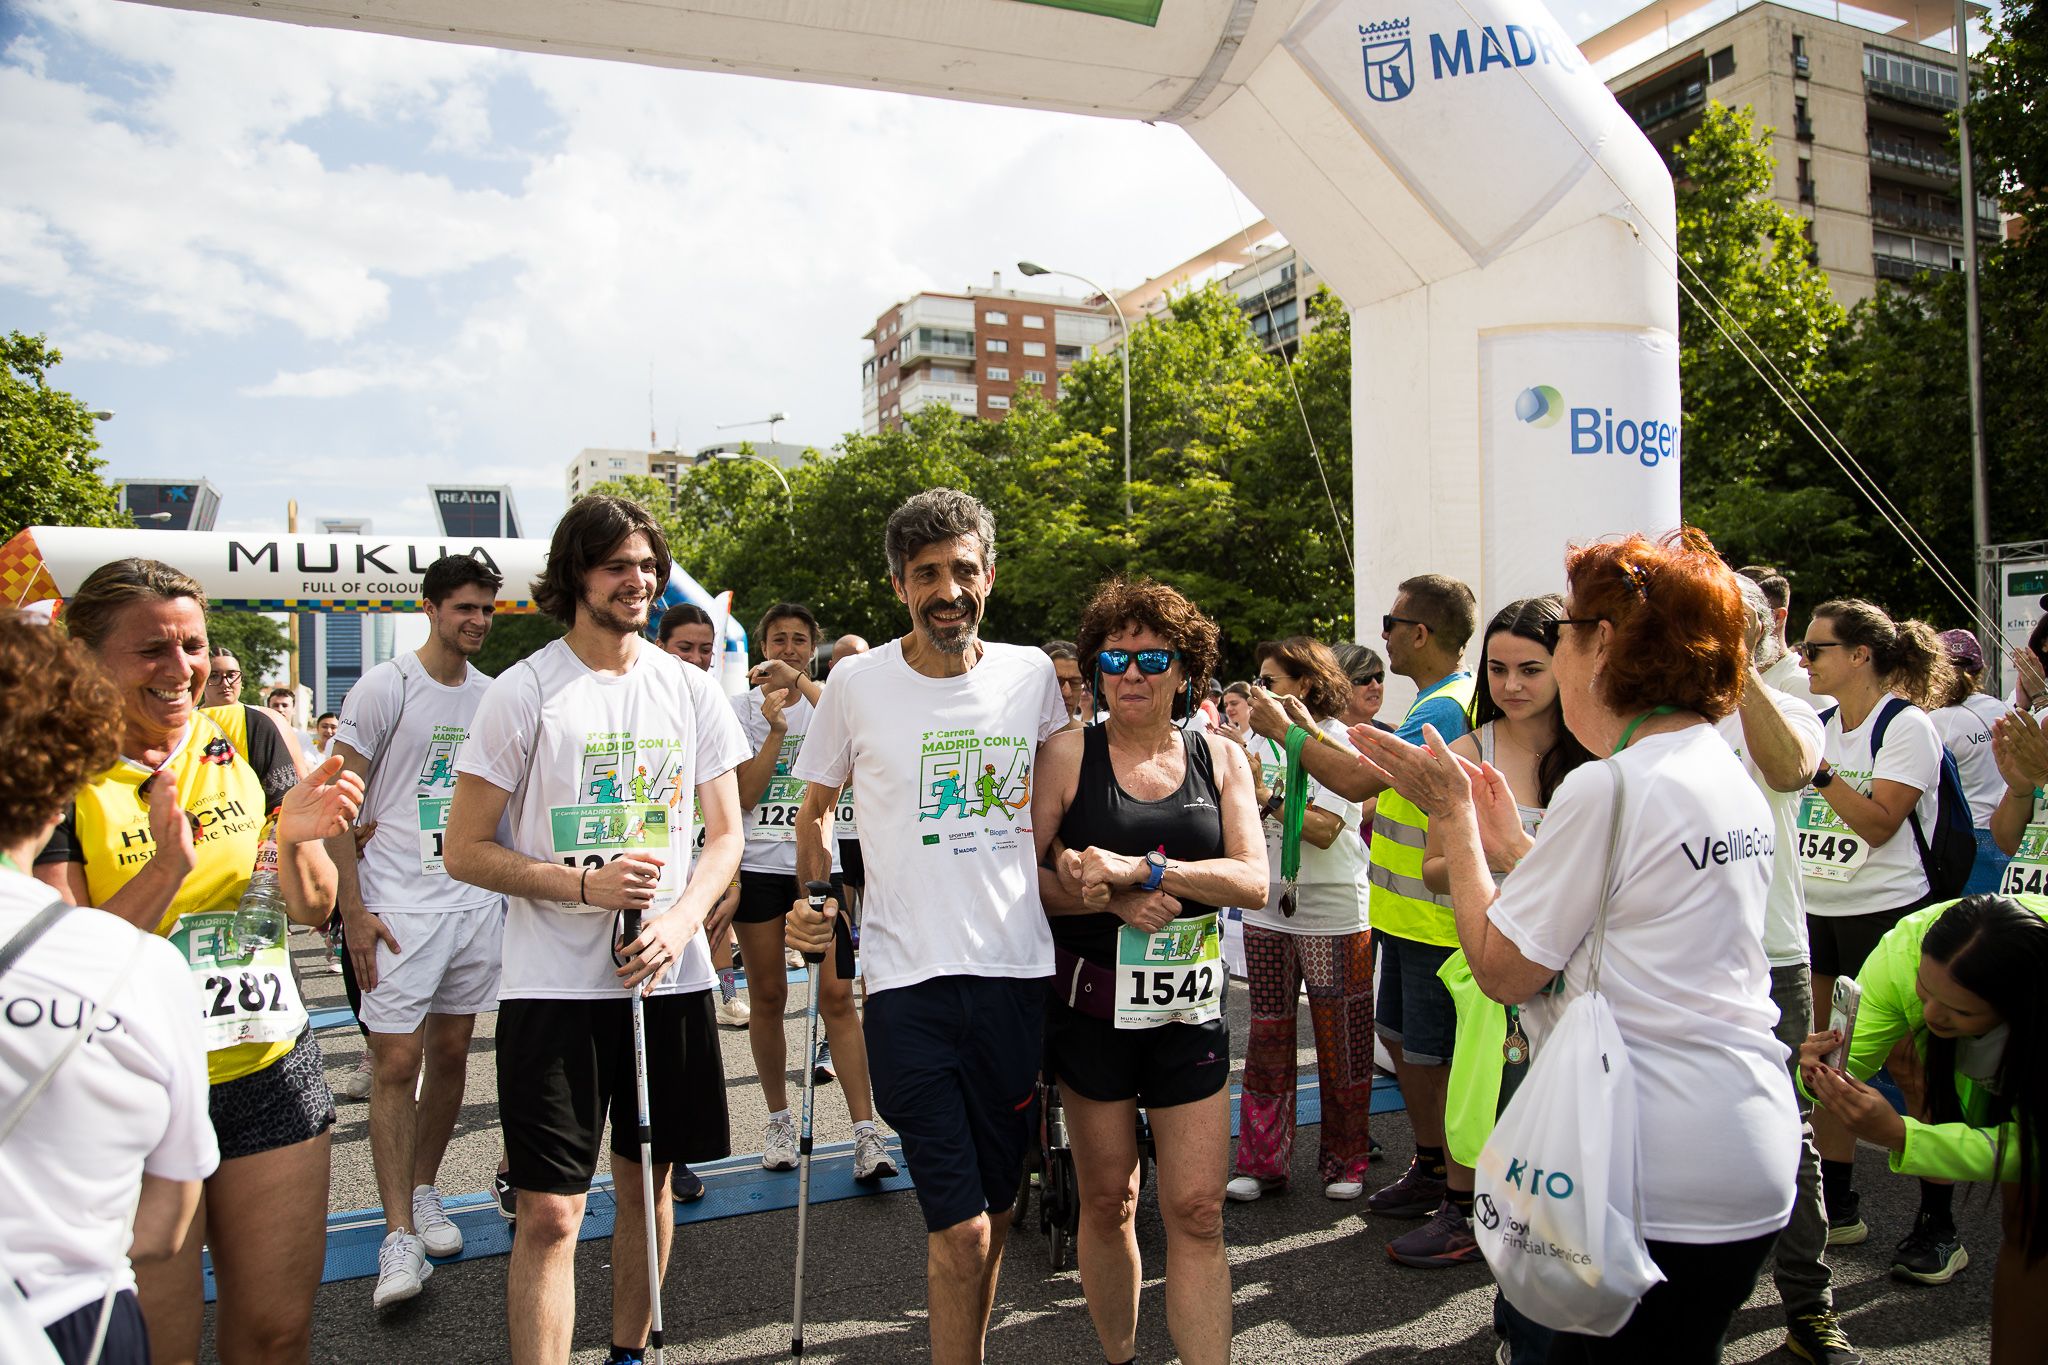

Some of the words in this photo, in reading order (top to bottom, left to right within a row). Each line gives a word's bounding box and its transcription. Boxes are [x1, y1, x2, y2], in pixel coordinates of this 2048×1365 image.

[1570, 407, 1679, 468] Biogen
[302, 582, 335, 594] FULL
[341, 582, 361, 594] OF
[432, 733, 465, 742] MADRID
[936, 728, 975, 738] Carrera
[638, 738, 664, 748] CON
[667, 738, 682, 748] LA
[921, 738, 980, 754] MADRID
[984, 736, 1011, 747] CON
[1013, 736, 1028, 747] LA
[1839, 769, 1859, 778] CON
[759, 805, 800, 827] 128
[576, 814, 646, 845] ELA
[190, 917, 228, 928] MADRID
[1144, 930, 1206, 962] ELA
[203, 971, 288, 1018] 282
[1130, 966, 1215, 1006] 1542
